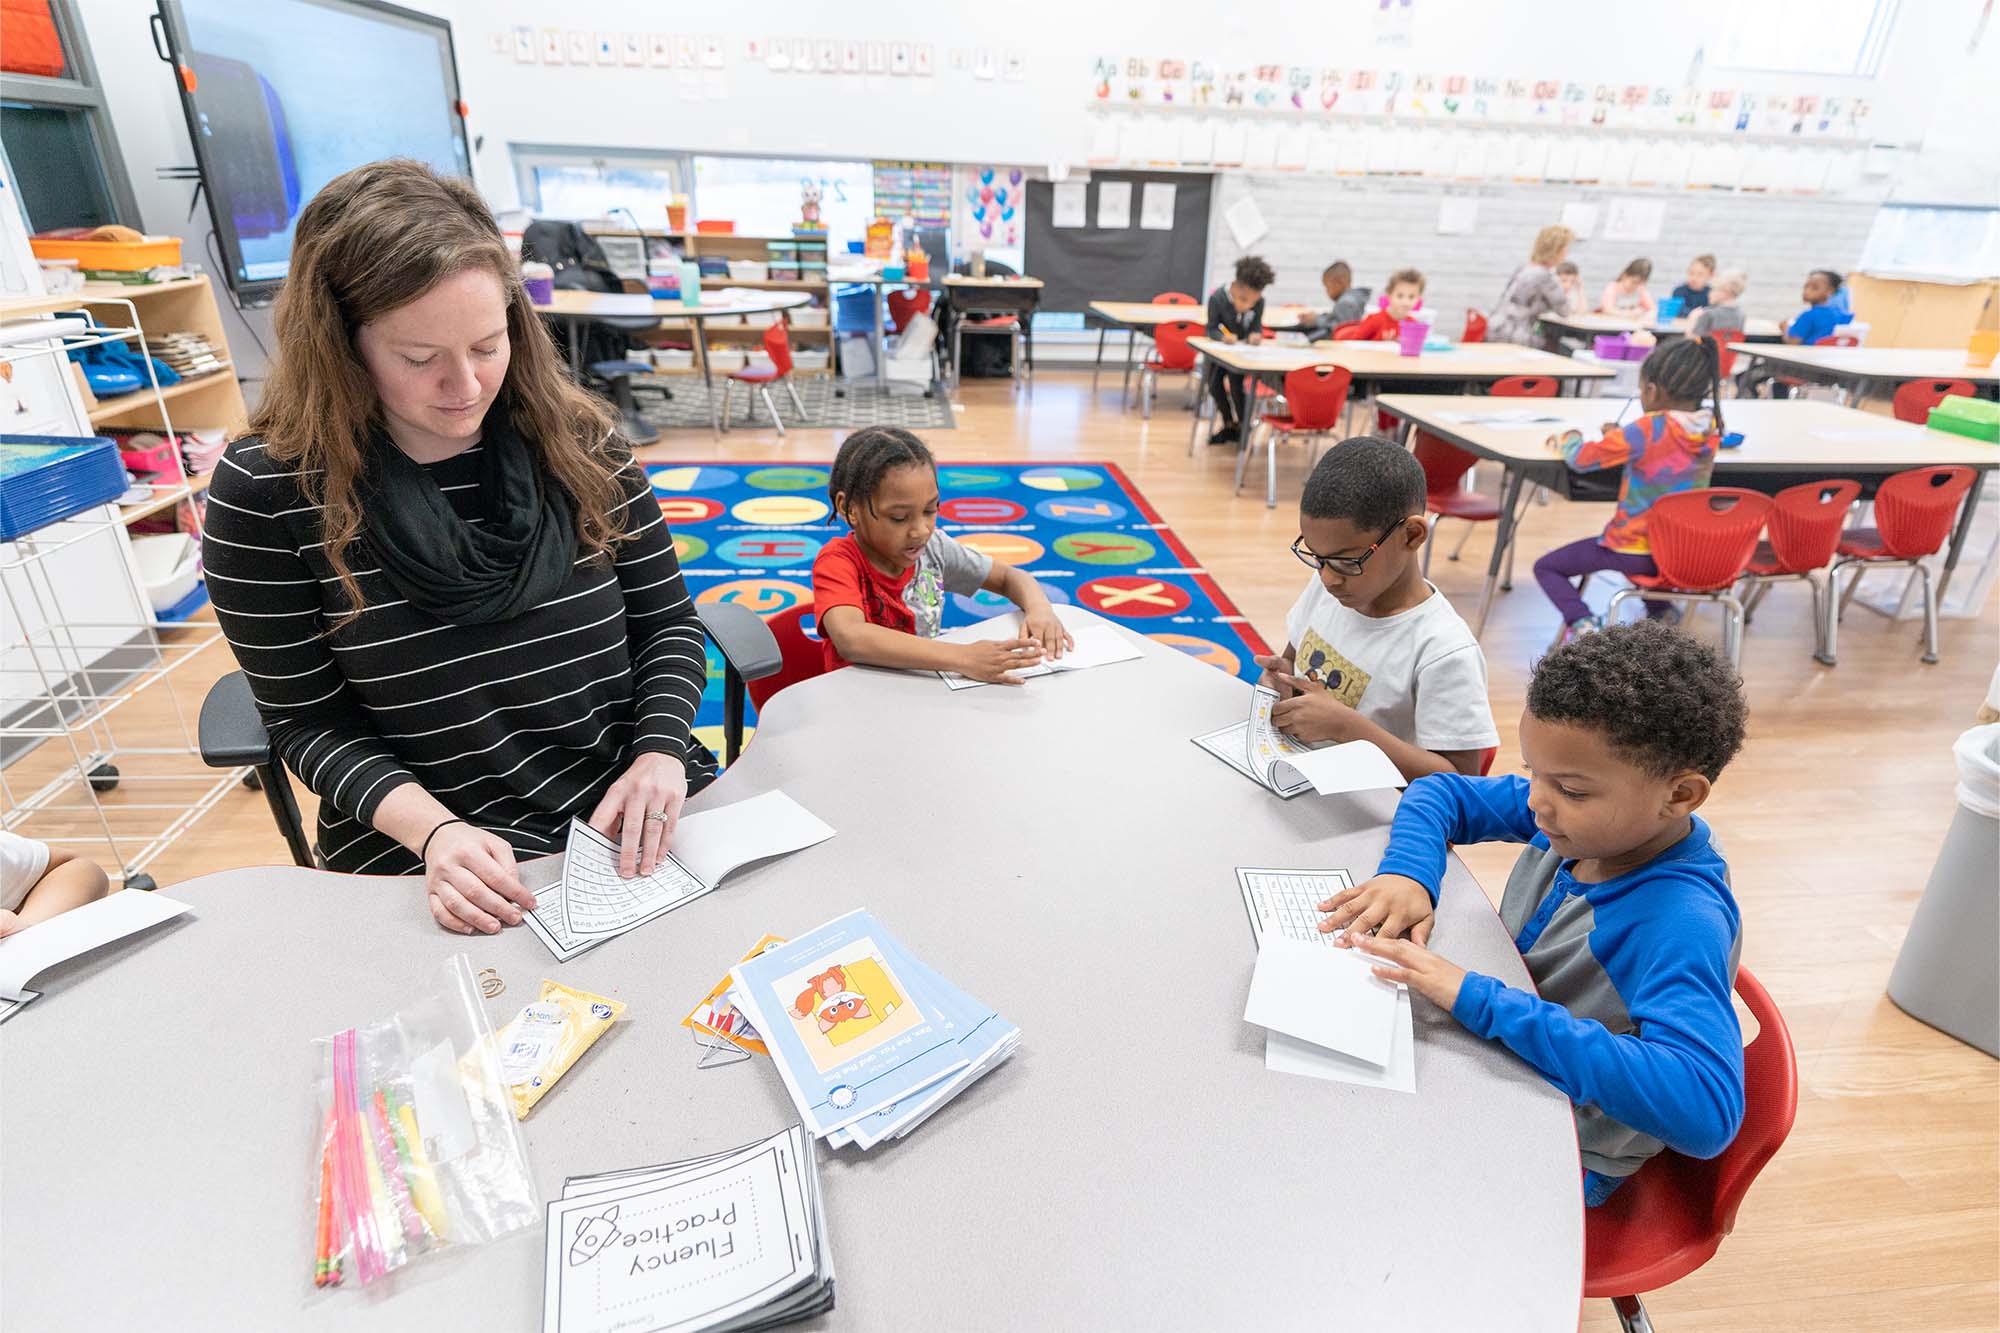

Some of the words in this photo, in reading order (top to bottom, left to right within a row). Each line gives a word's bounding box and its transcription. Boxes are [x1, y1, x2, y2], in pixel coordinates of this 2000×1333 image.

[1095, 59, 1117, 77] Aa
[1127, 59, 1148, 77] Bb
[1160, 60, 1183, 78] Cc
[1446, 75, 1464, 94] Ll
[1595, 84, 1616, 105] Qq
[1655, 86, 1672, 105] Ss
[944, 472, 1001, 486] V
[954, 504, 1015, 517] U
[1050, 503, 1112, 517] Z
[736, 541, 806, 557] H
[1070, 540, 1136, 557] Y
[1091, 582, 1177, 608] X
[623, 1202, 737, 1248] Practice
[630, 1231, 734, 1276] Fluency
